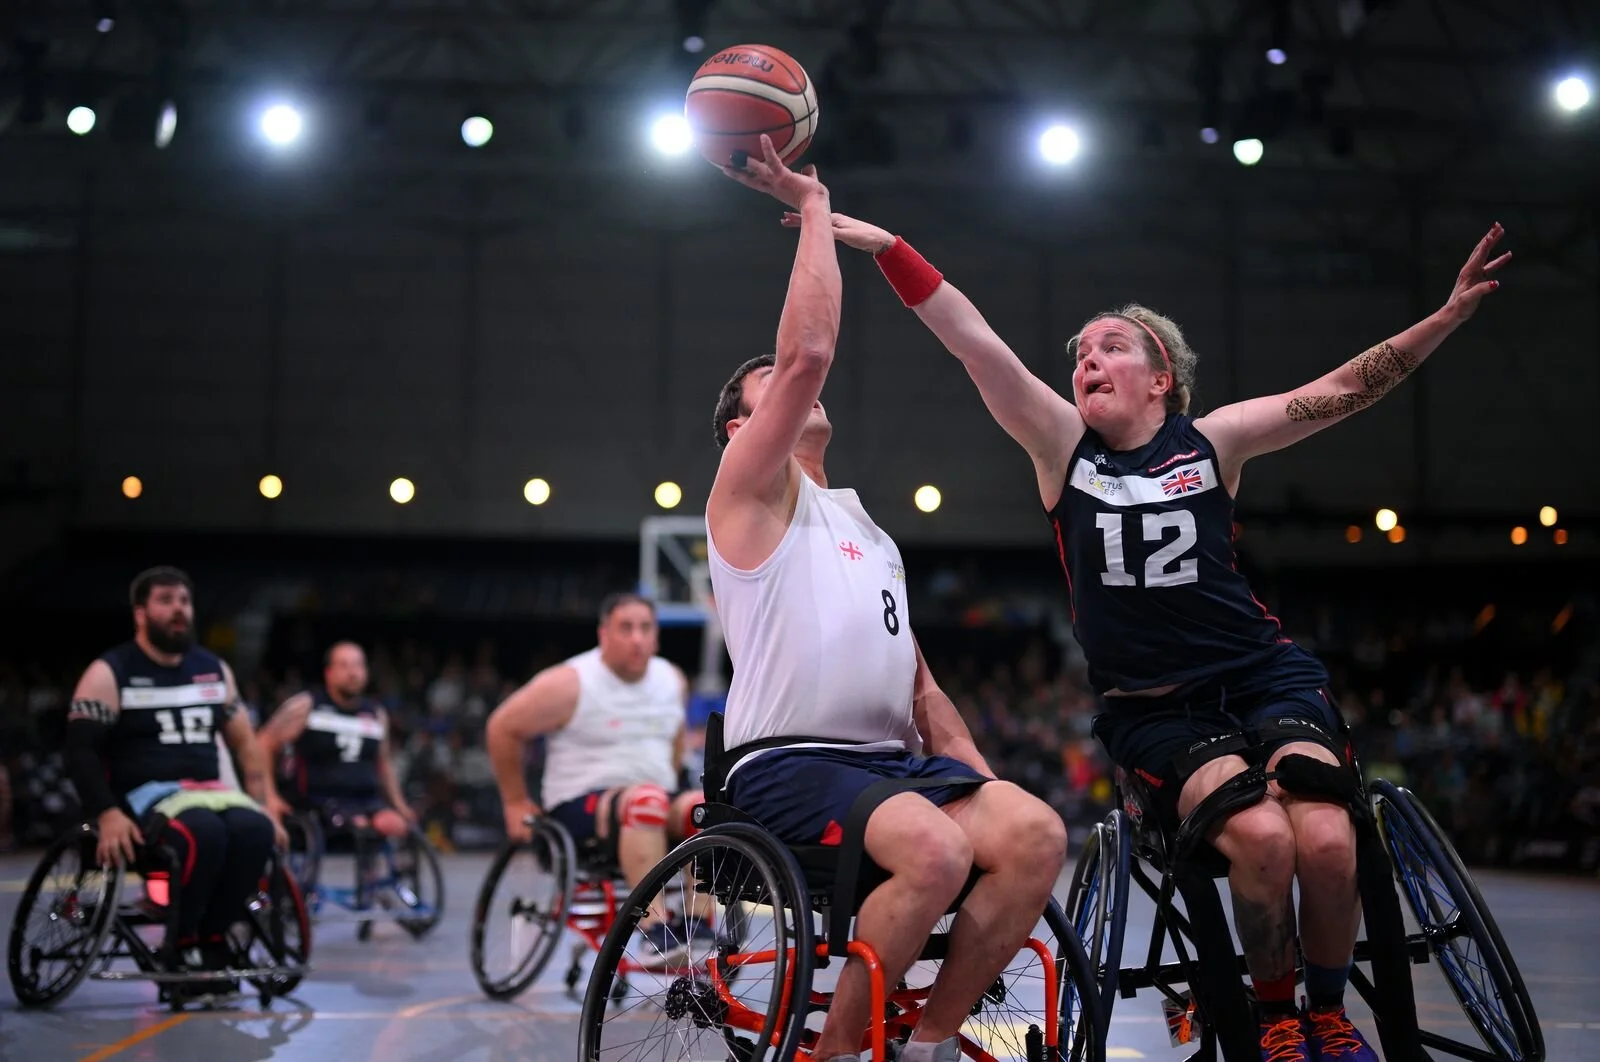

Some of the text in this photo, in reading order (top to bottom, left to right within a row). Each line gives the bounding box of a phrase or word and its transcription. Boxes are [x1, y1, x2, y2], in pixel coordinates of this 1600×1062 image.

[704, 53, 775, 73] molten
[1095, 509, 1198, 588] 12
[881, 589, 900, 636] 8
